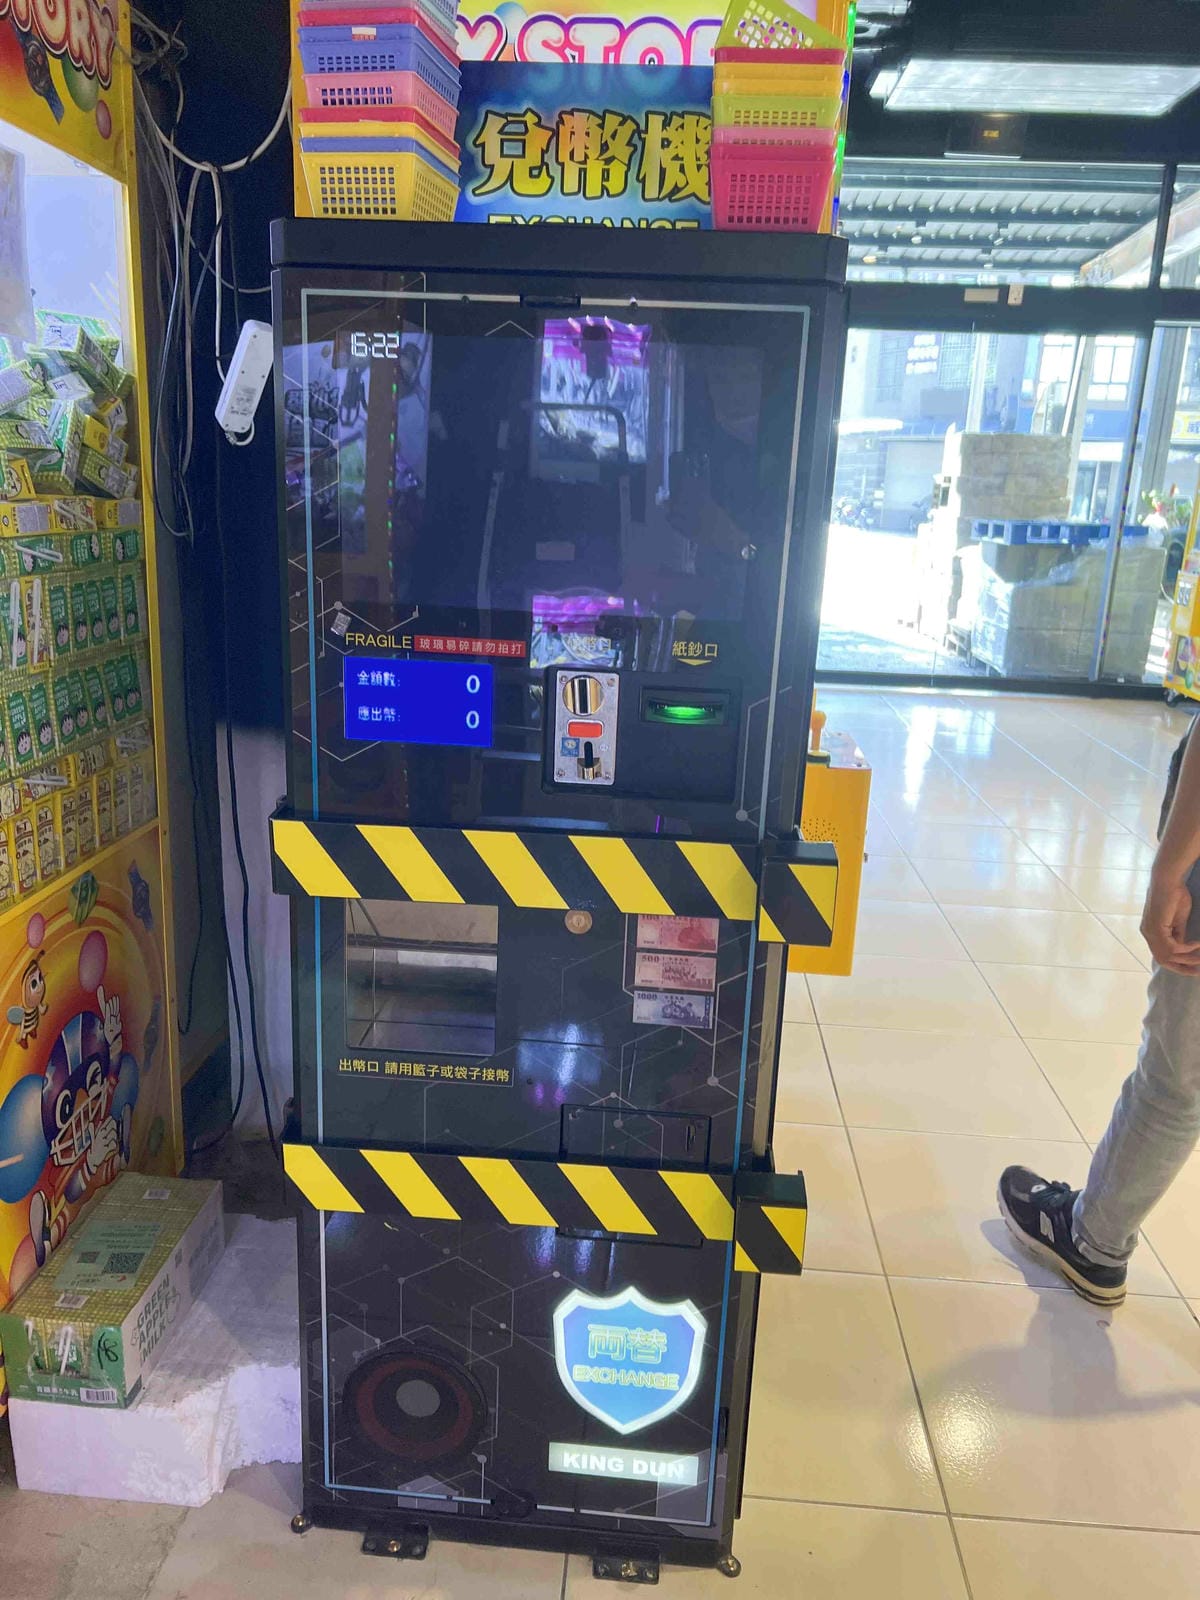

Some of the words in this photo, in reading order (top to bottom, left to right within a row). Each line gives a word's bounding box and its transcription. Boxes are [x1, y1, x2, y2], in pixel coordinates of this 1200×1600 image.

[345, 632, 412, 649] FRAGILE
[418, 637, 523, 656] 玻璃易碎請勿拍打
[671, 640, 719, 658] 紙鈔口
[466, 674, 481, 694] 0
[465, 710, 480, 730] 0
[641, 954, 660, 963] 500
[338, 1058, 380, 1073] 出幣口
[384, 1060, 510, 1083] 請用籃子或袋子接幣
[572, 1363, 680, 1391] EXCHANGE
[562, 1452, 625, 1473] KING
[632, 1459, 686, 1480] DUN
